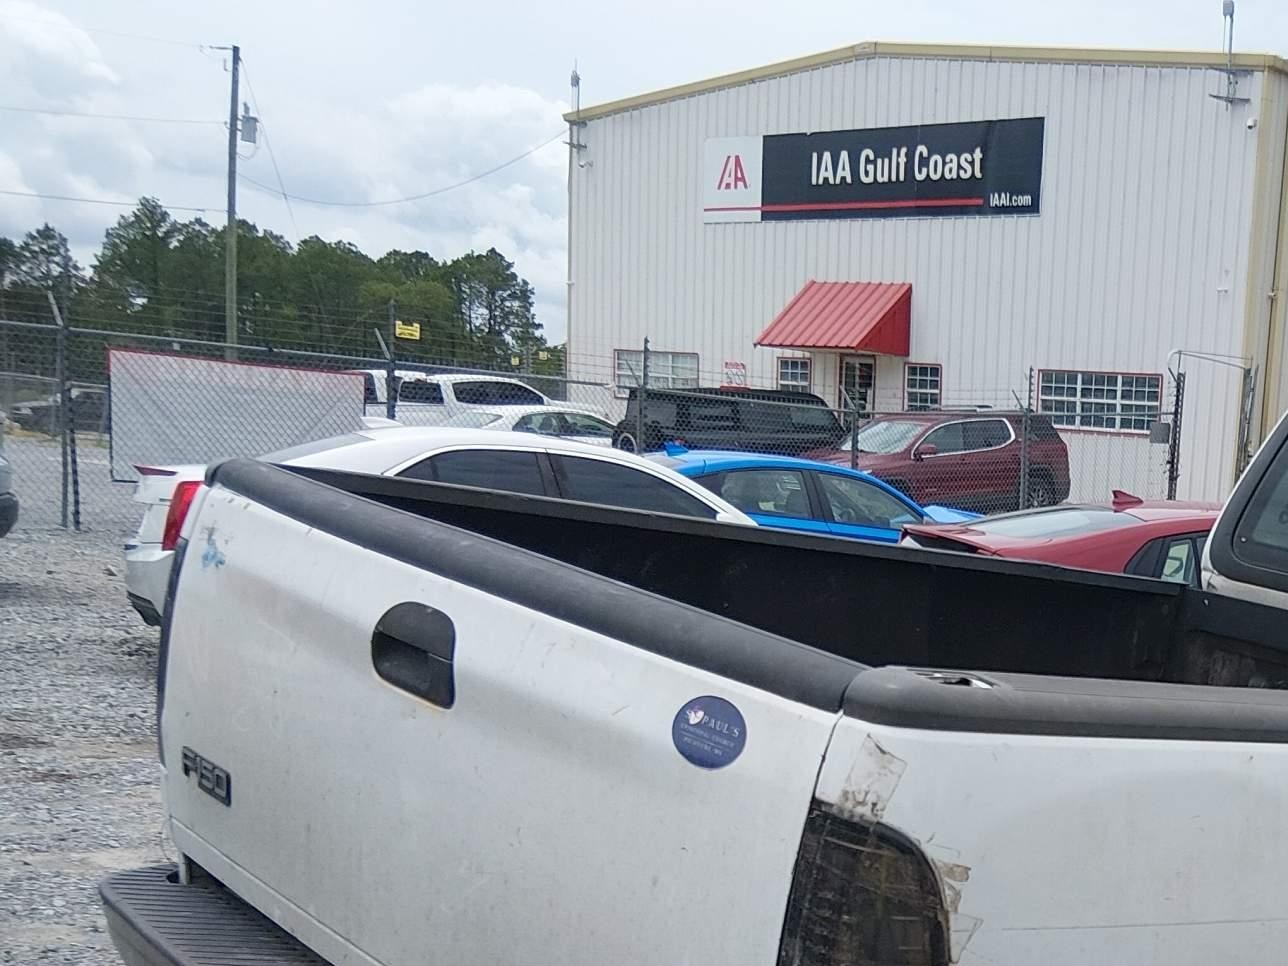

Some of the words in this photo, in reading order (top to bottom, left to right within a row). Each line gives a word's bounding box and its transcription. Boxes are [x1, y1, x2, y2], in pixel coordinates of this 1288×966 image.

[810, 150, 852, 187] IAA
[859, 146, 908, 184] Gulf
[914, 143, 984, 182] Coast
[989, 191, 1032, 207] IAAI.com
